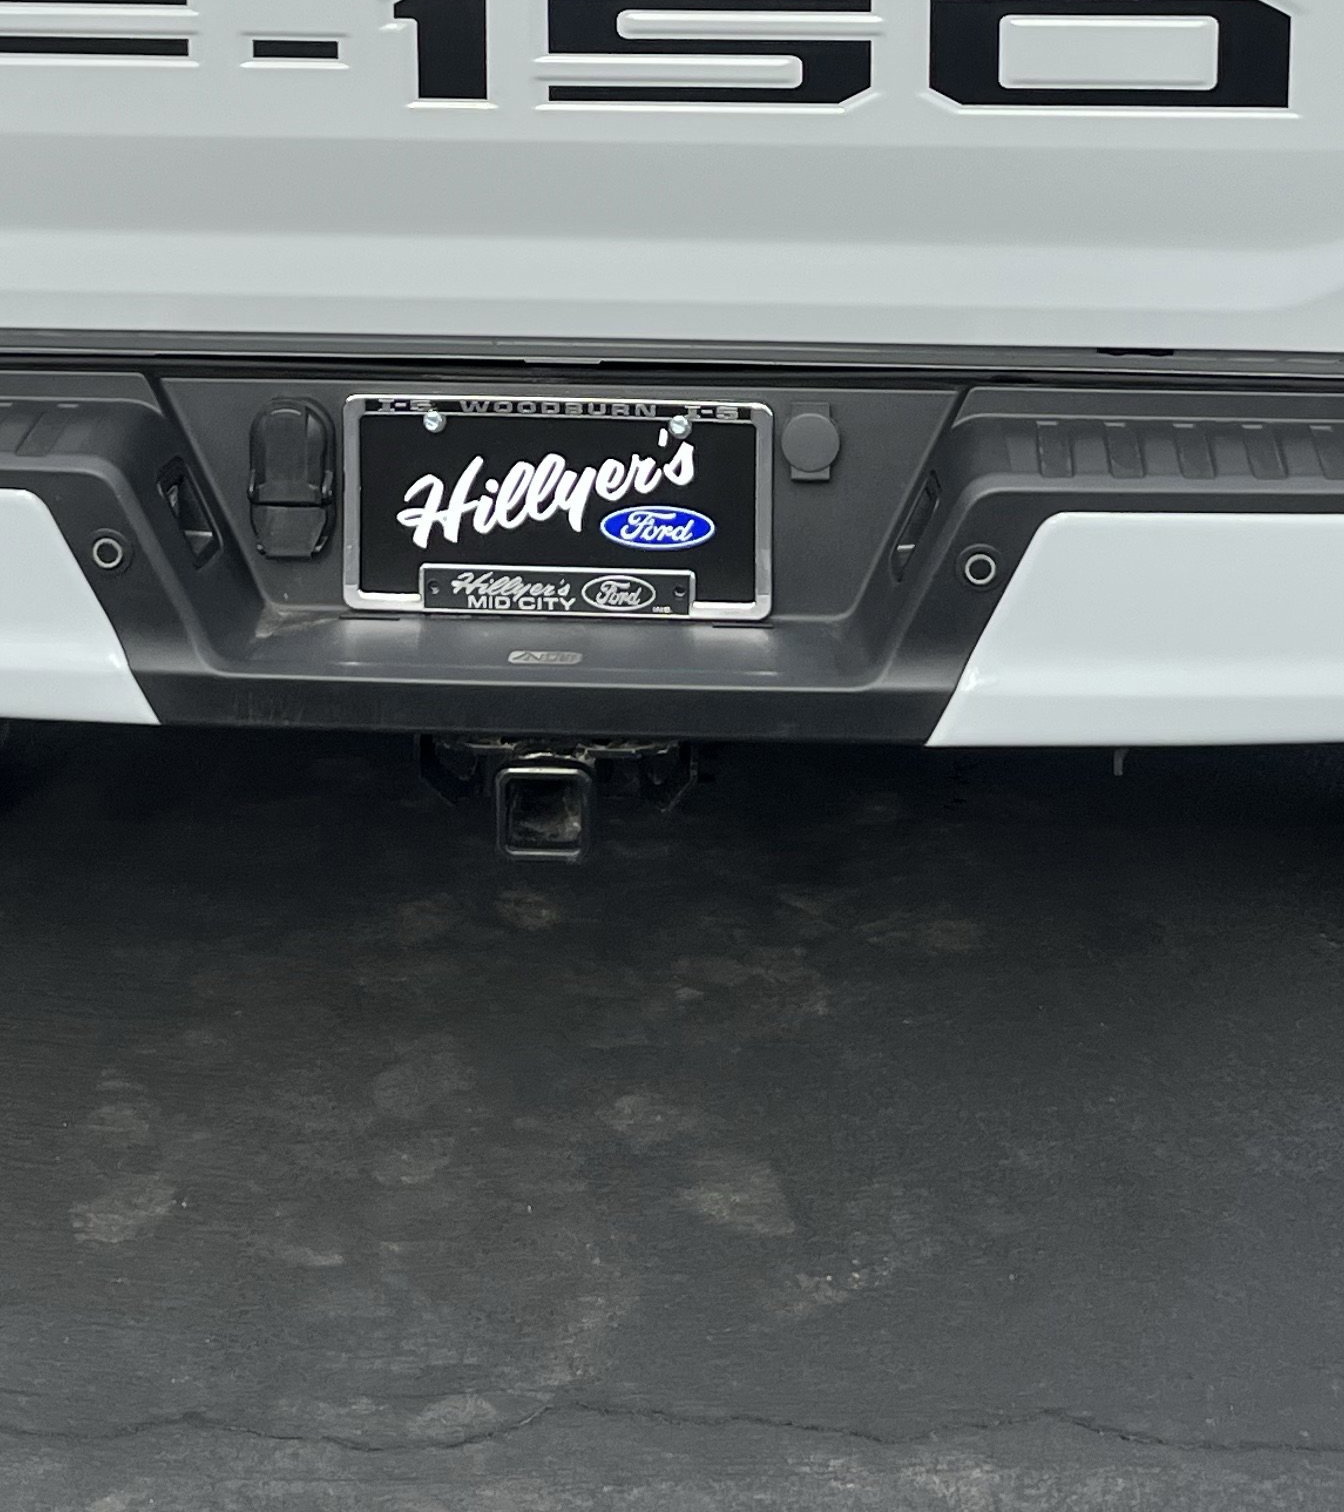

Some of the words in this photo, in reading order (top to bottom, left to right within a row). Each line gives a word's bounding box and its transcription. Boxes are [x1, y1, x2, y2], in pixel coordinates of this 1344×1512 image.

[377, 398, 433, 413] I-5
[459, 399, 657, 418] WOODBURN
[684, 405, 739, 420] I-5
[396, 428, 695, 549] Hillyer's
[619, 510, 695, 542] Ford
[450, 571, 570, 602] Hillyer's
[595, 580, 641, 606] Ford
[467, 594, 511, 609] MID
[517, 596, 576, 611] CITY
